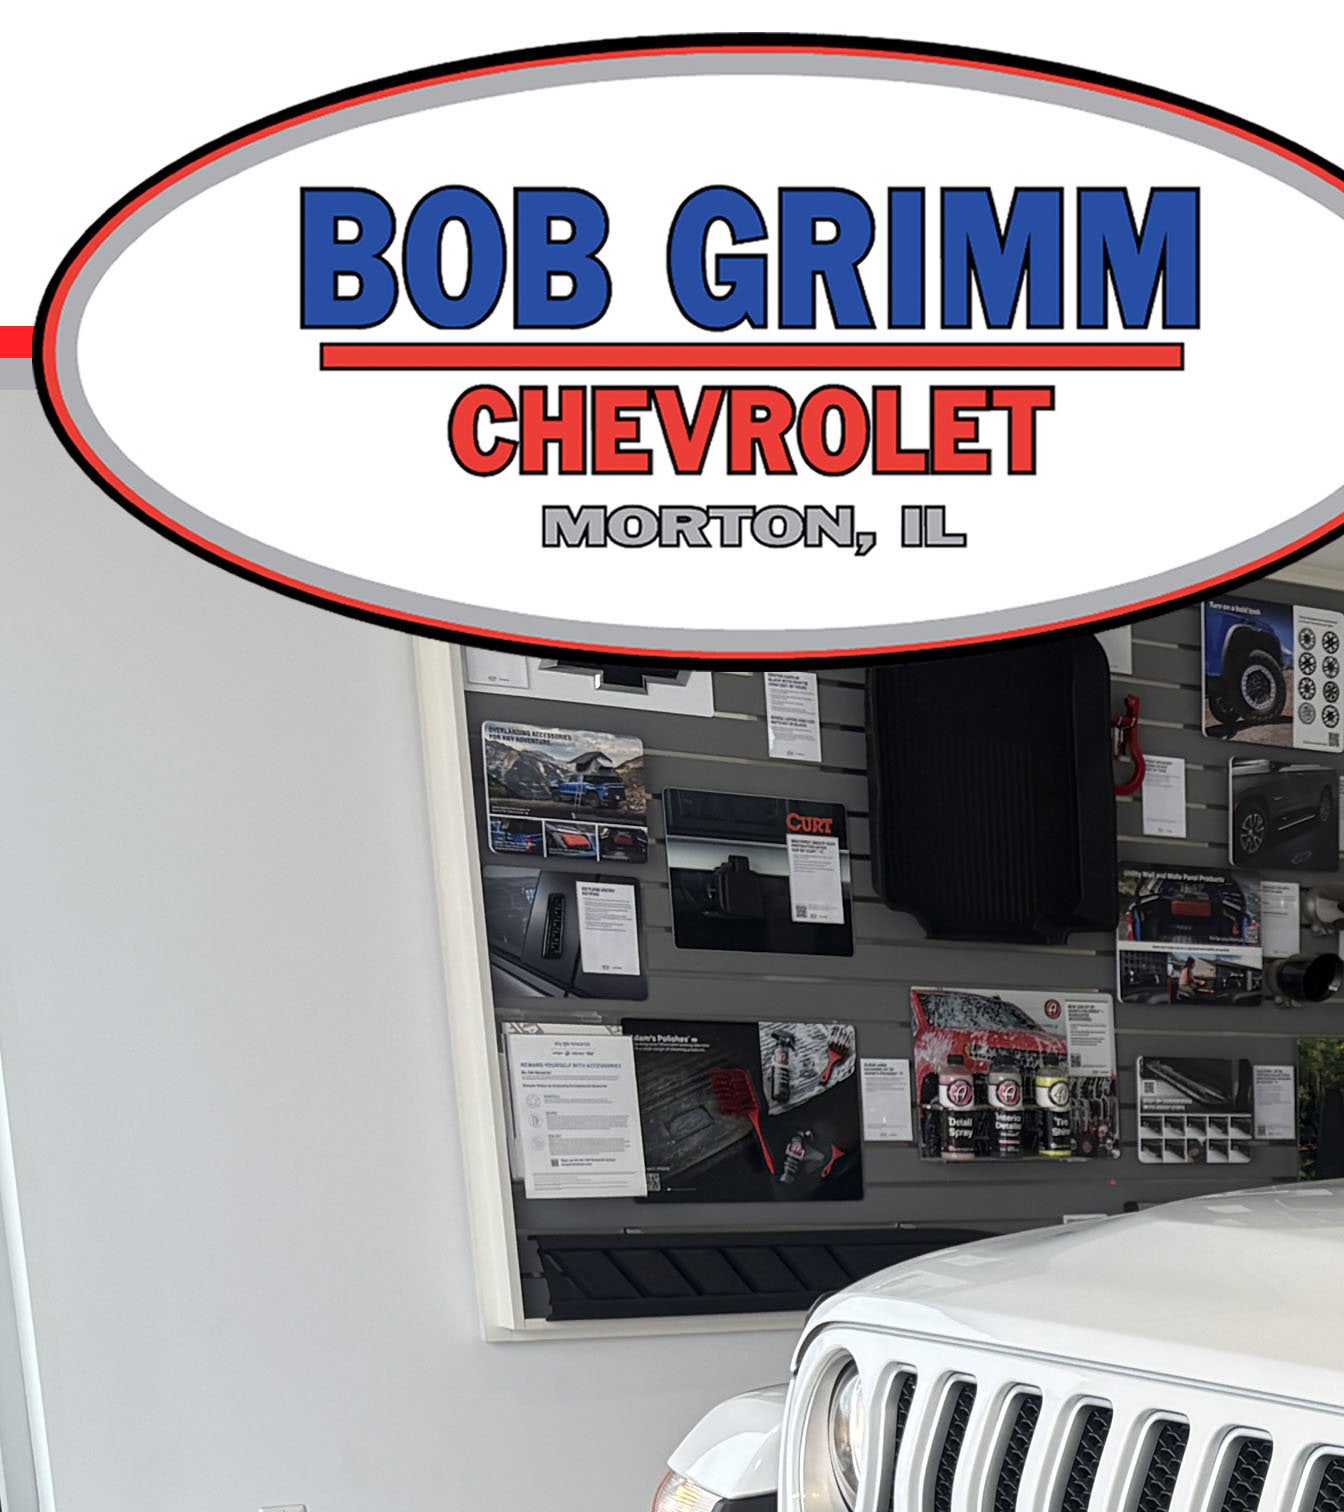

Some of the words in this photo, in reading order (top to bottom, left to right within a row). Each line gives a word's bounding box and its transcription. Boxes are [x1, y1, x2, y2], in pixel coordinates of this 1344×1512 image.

[786, 812, 833, 834] CURT
[948, 1116, 973, 1127] Detail
[948, 1128, 973, 1139] Spray
